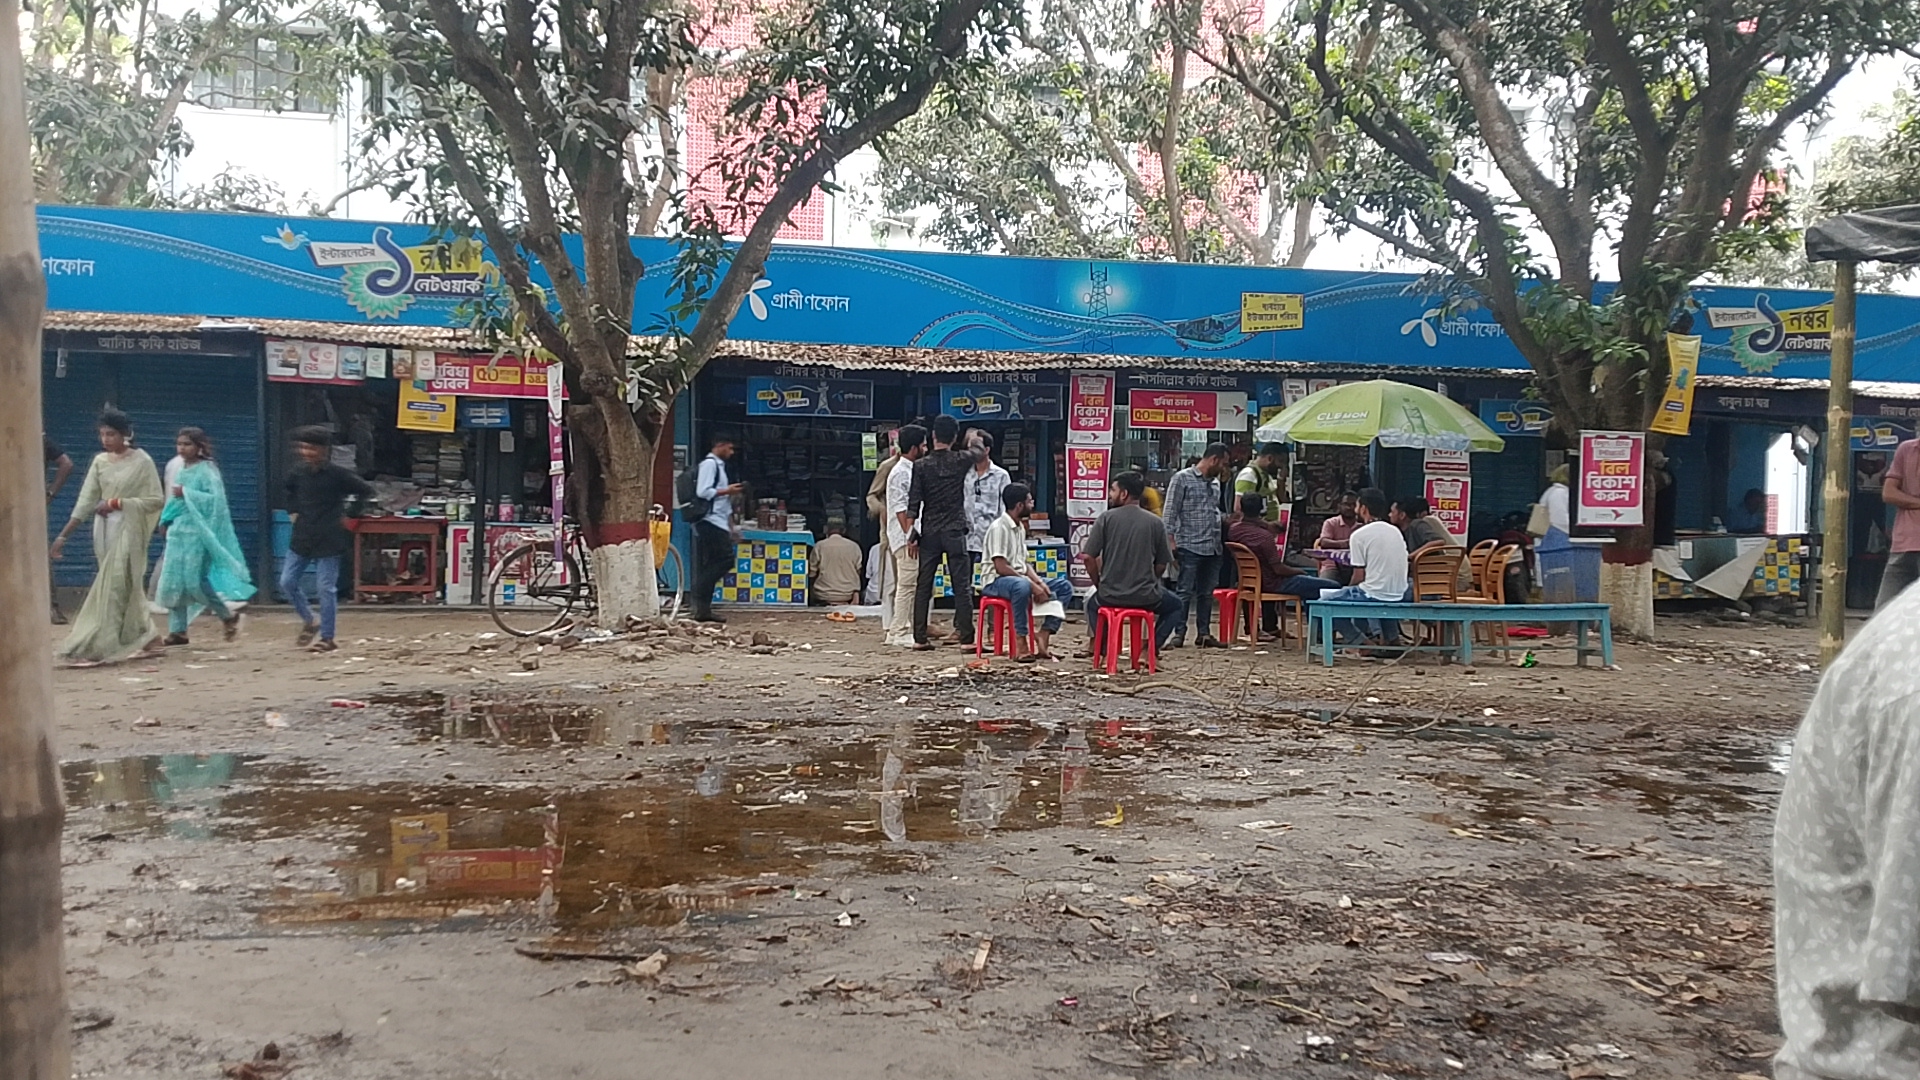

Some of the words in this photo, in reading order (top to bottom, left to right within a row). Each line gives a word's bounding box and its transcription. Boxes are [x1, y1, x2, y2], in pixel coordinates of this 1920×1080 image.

[319, 247, 375, 259] ইন্টারনেটের
[41, 256, 95, 277] ণফোন
[414, 275, 482, 293] নেটওয়ার্ক
[771, 289, 850, 312] গ্রামীণফোন
[1714, 311, 1757, 322] ইন্টারনেটের
[1789, 309, 1830, 330] নম্বর
[138, 335, 164, 350] কফি
[167, 337, 202, 351] হাউজ
[1785, 335, 1833, 351] নেটওয়া
[1186, 373, 1208, 386] কফি
[1074, 403, 1110, 417] বিকাশ
[1078, 418, 1104, 427] করুন
[1599, 459, 1631, 475] বিল
[1585, 471, 1637, 489] বিকাশ
[1438, 497, 1460, 509] বিল
[1592, 490, 1630, 501] করুন
